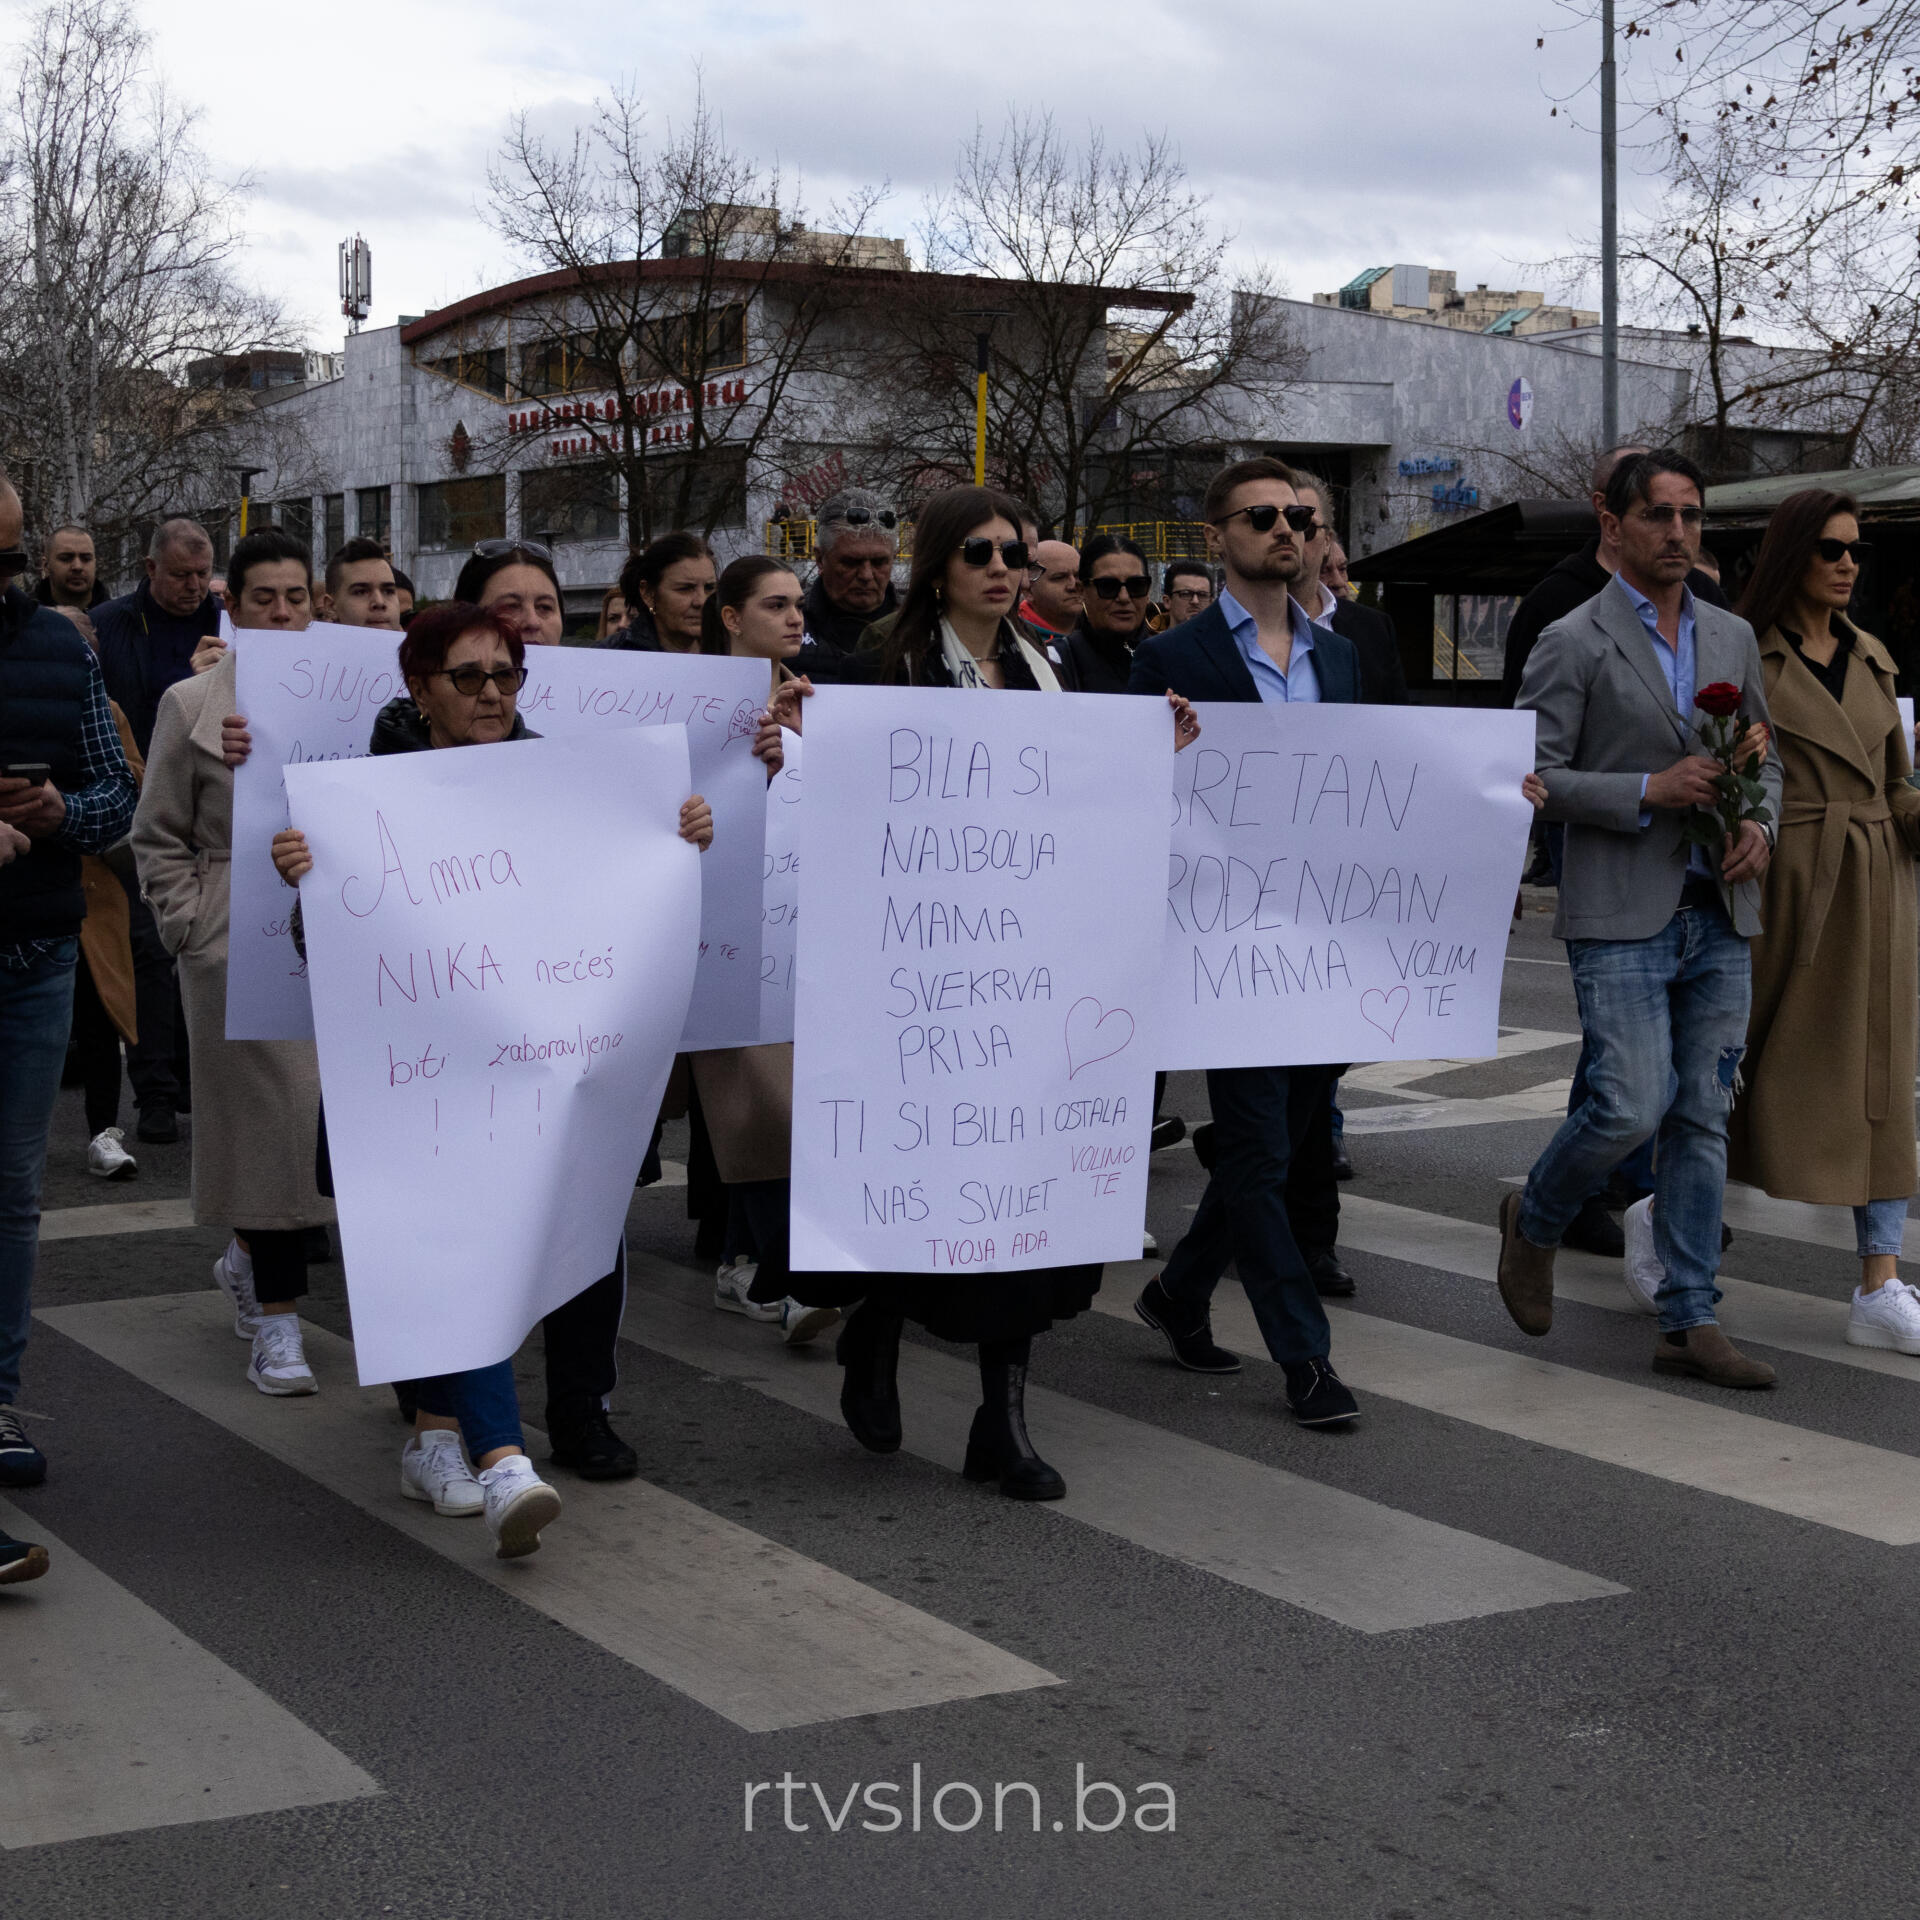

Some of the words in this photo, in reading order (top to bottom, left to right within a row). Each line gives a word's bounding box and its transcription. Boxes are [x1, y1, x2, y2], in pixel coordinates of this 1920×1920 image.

[279, 658, 401, 722] SINJO
[578, 685, 675, 725] VOLIM
[686, 695, 726, 725] TE
[889, 728, 991, 803] BILA
[1013, 746, 1050, 796] SI
[341, 809, 521, 917] Amra
[881, 822, 1056, 880] NAJBOLJA
[882, 895, 1022, 952] MAMA
[378, 942, 504, 1006] NIKA
[886, 967, 1052, 1018] SVEKRVA
[1193, 939, 1353, 1004] MAMA
[1387, 937, 1477, 981] VOLIM
[1423, 983, 1457, 1017] TE
[388, 1042, 451, 1087] biti
[488, 1023, 624, 1075] zaboravljena
[898, 1025, 1013, 1084] PRIJA
[819, 1100, 865, 1158] TI
[893, 1101, 930, 1152] SI
[952, 1102, 1025, 1147] BILA
[1054, 1096, 1127, 1132] OSTALA
[1071, 1144, 1136, 1173] VOLIMO
[1090, 1171, 1122, 1198] TE
[864, 1179, 930, 1225] NAŠ
[925, 1238, 995, 1267] TVOJA
